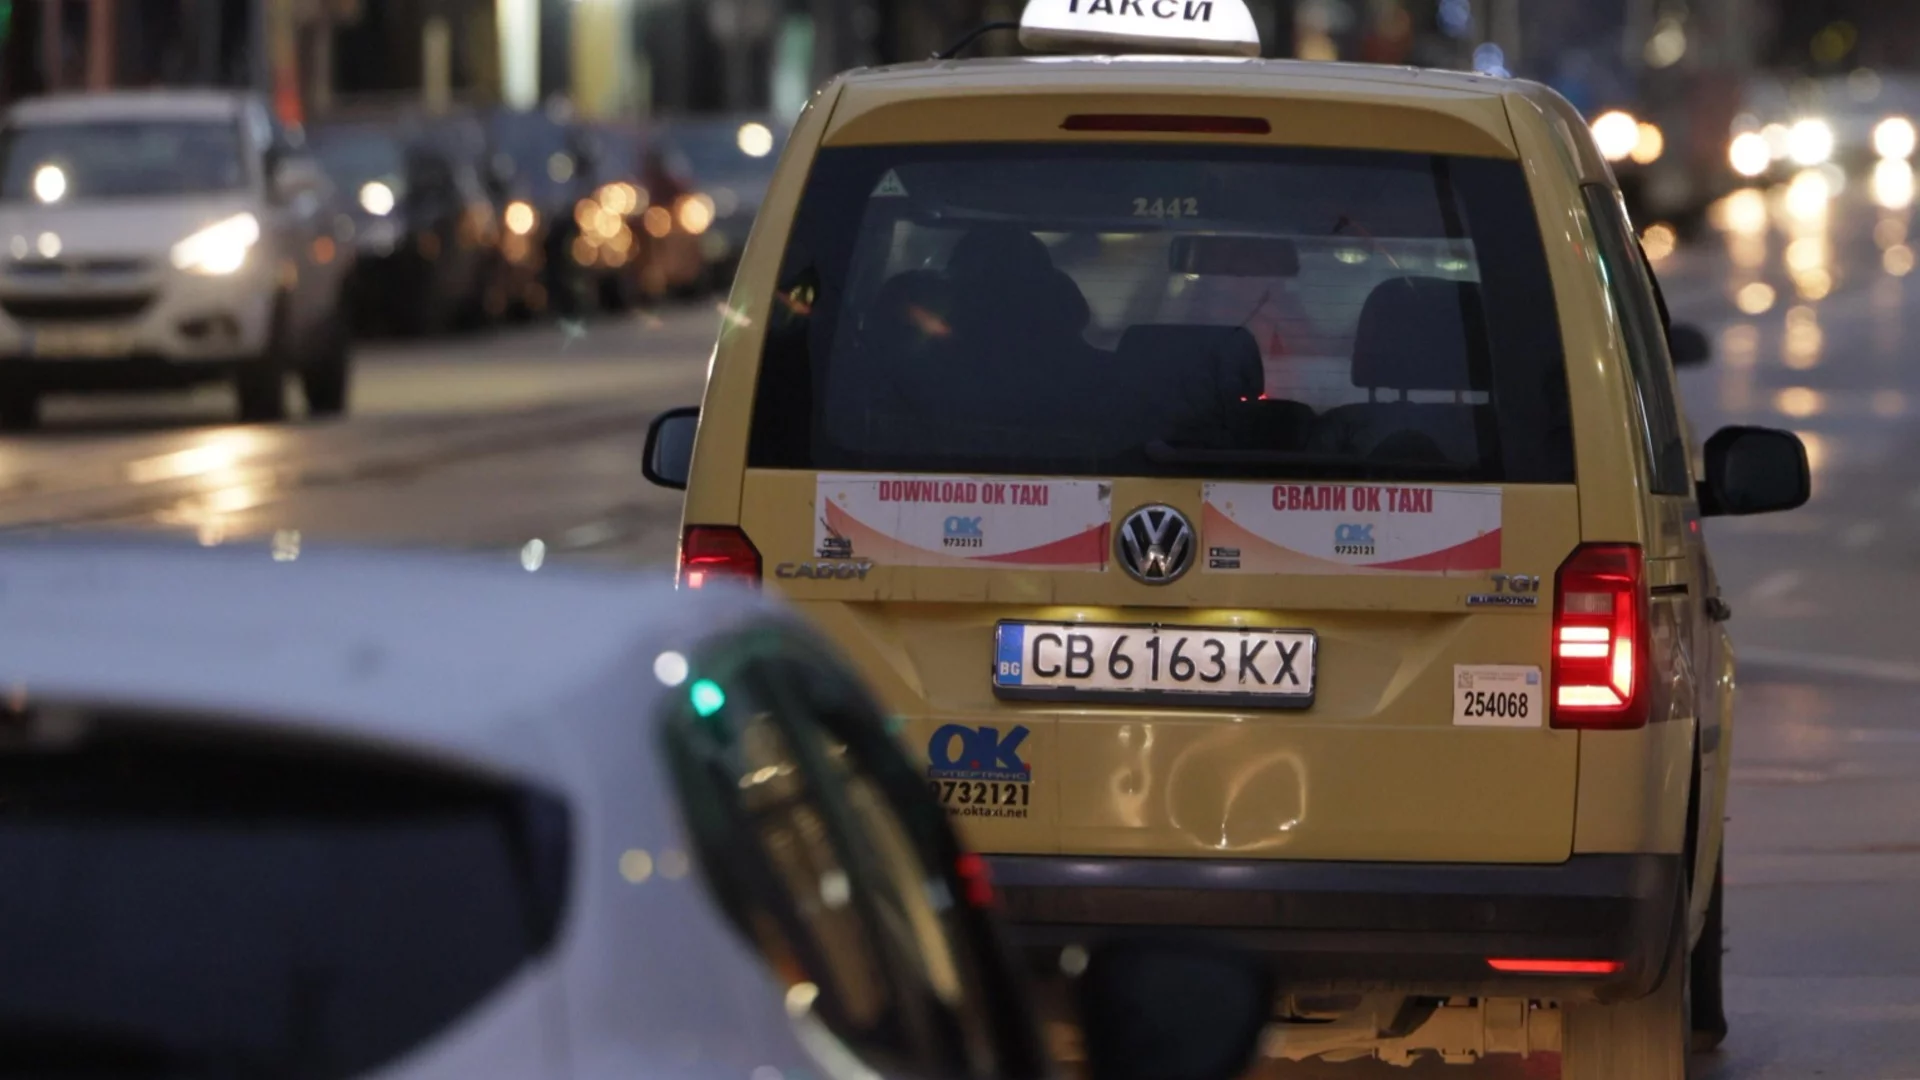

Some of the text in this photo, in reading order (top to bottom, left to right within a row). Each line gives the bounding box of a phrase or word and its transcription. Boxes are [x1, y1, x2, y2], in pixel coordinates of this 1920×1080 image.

[1132, 197, 1199, 218] 2442
[878, 480, 1049, 506] DOWNLOAD OK TAXI
[1271, 485, 1347, 512] СВАЛИ
[1385, 488, 1434, 513] TAXI
[943, 515, 983, 537] OK
[1334, 523, 1375, 545] OK
[943, 537, 983, 548] 9732121
[1334, 545, 1375, 555] 9732121
[775, 561, 874, 581] CADDY
[1491, 574, 1539, 593] TGI
[1000, 661, 1021, 676] BG
[1108, 635, 1226, 683] 6163
[1463, 691, 1529, 718] 254068
